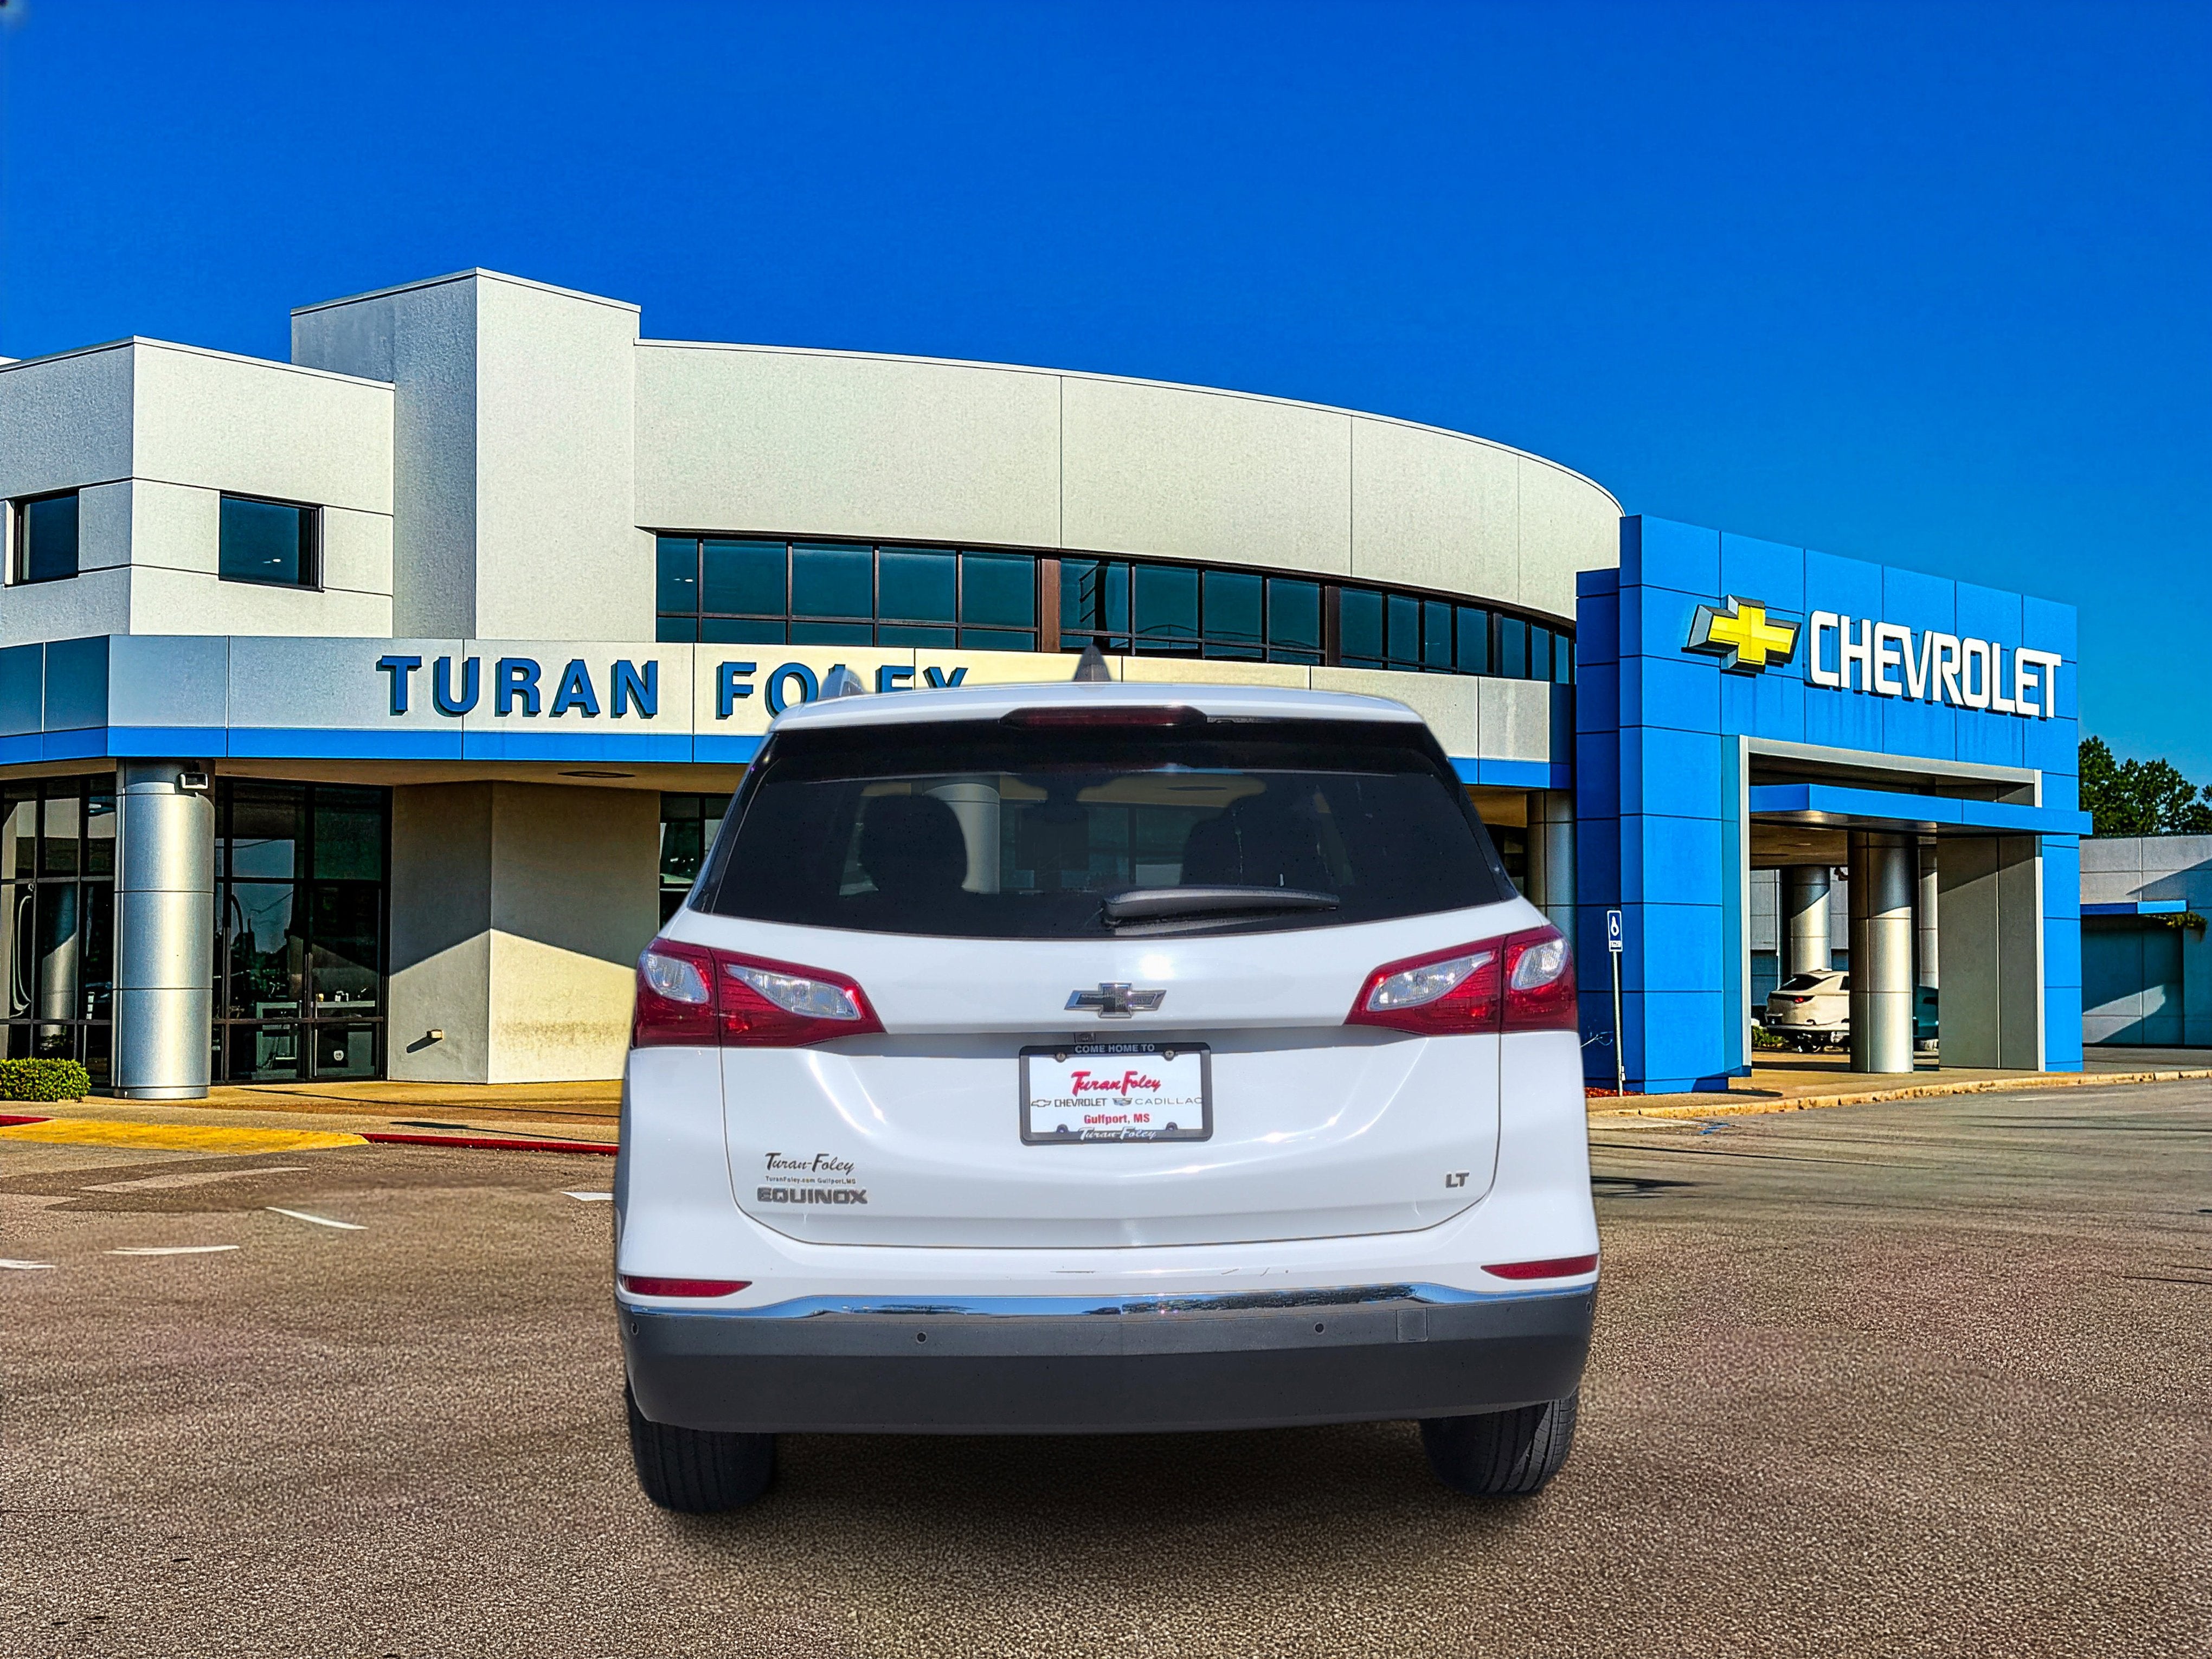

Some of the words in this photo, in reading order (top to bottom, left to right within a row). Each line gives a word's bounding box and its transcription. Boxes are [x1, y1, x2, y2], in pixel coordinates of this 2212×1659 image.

[1810, 610, 2062, 718] CHEVROLET
[377, 655, 658, 718] TURAN
[1075, 1044, 1106, 1053] COME
[1108, 1044, 1139, 1053] HOME
[1141, 1043, 1155, 1052] TO
[1054, 1097, 1108, 1107] CHEVROLET
[1135, 1097, 1203, 1105] CADILLAC
[1084, 1114, 1130, 1125] Gulfport,
[1133, 1113, 1150, 1123] MS
[1445, 1172, 1470, 1188] LT
[757, 1186, 869, 1204] EQUINOX
